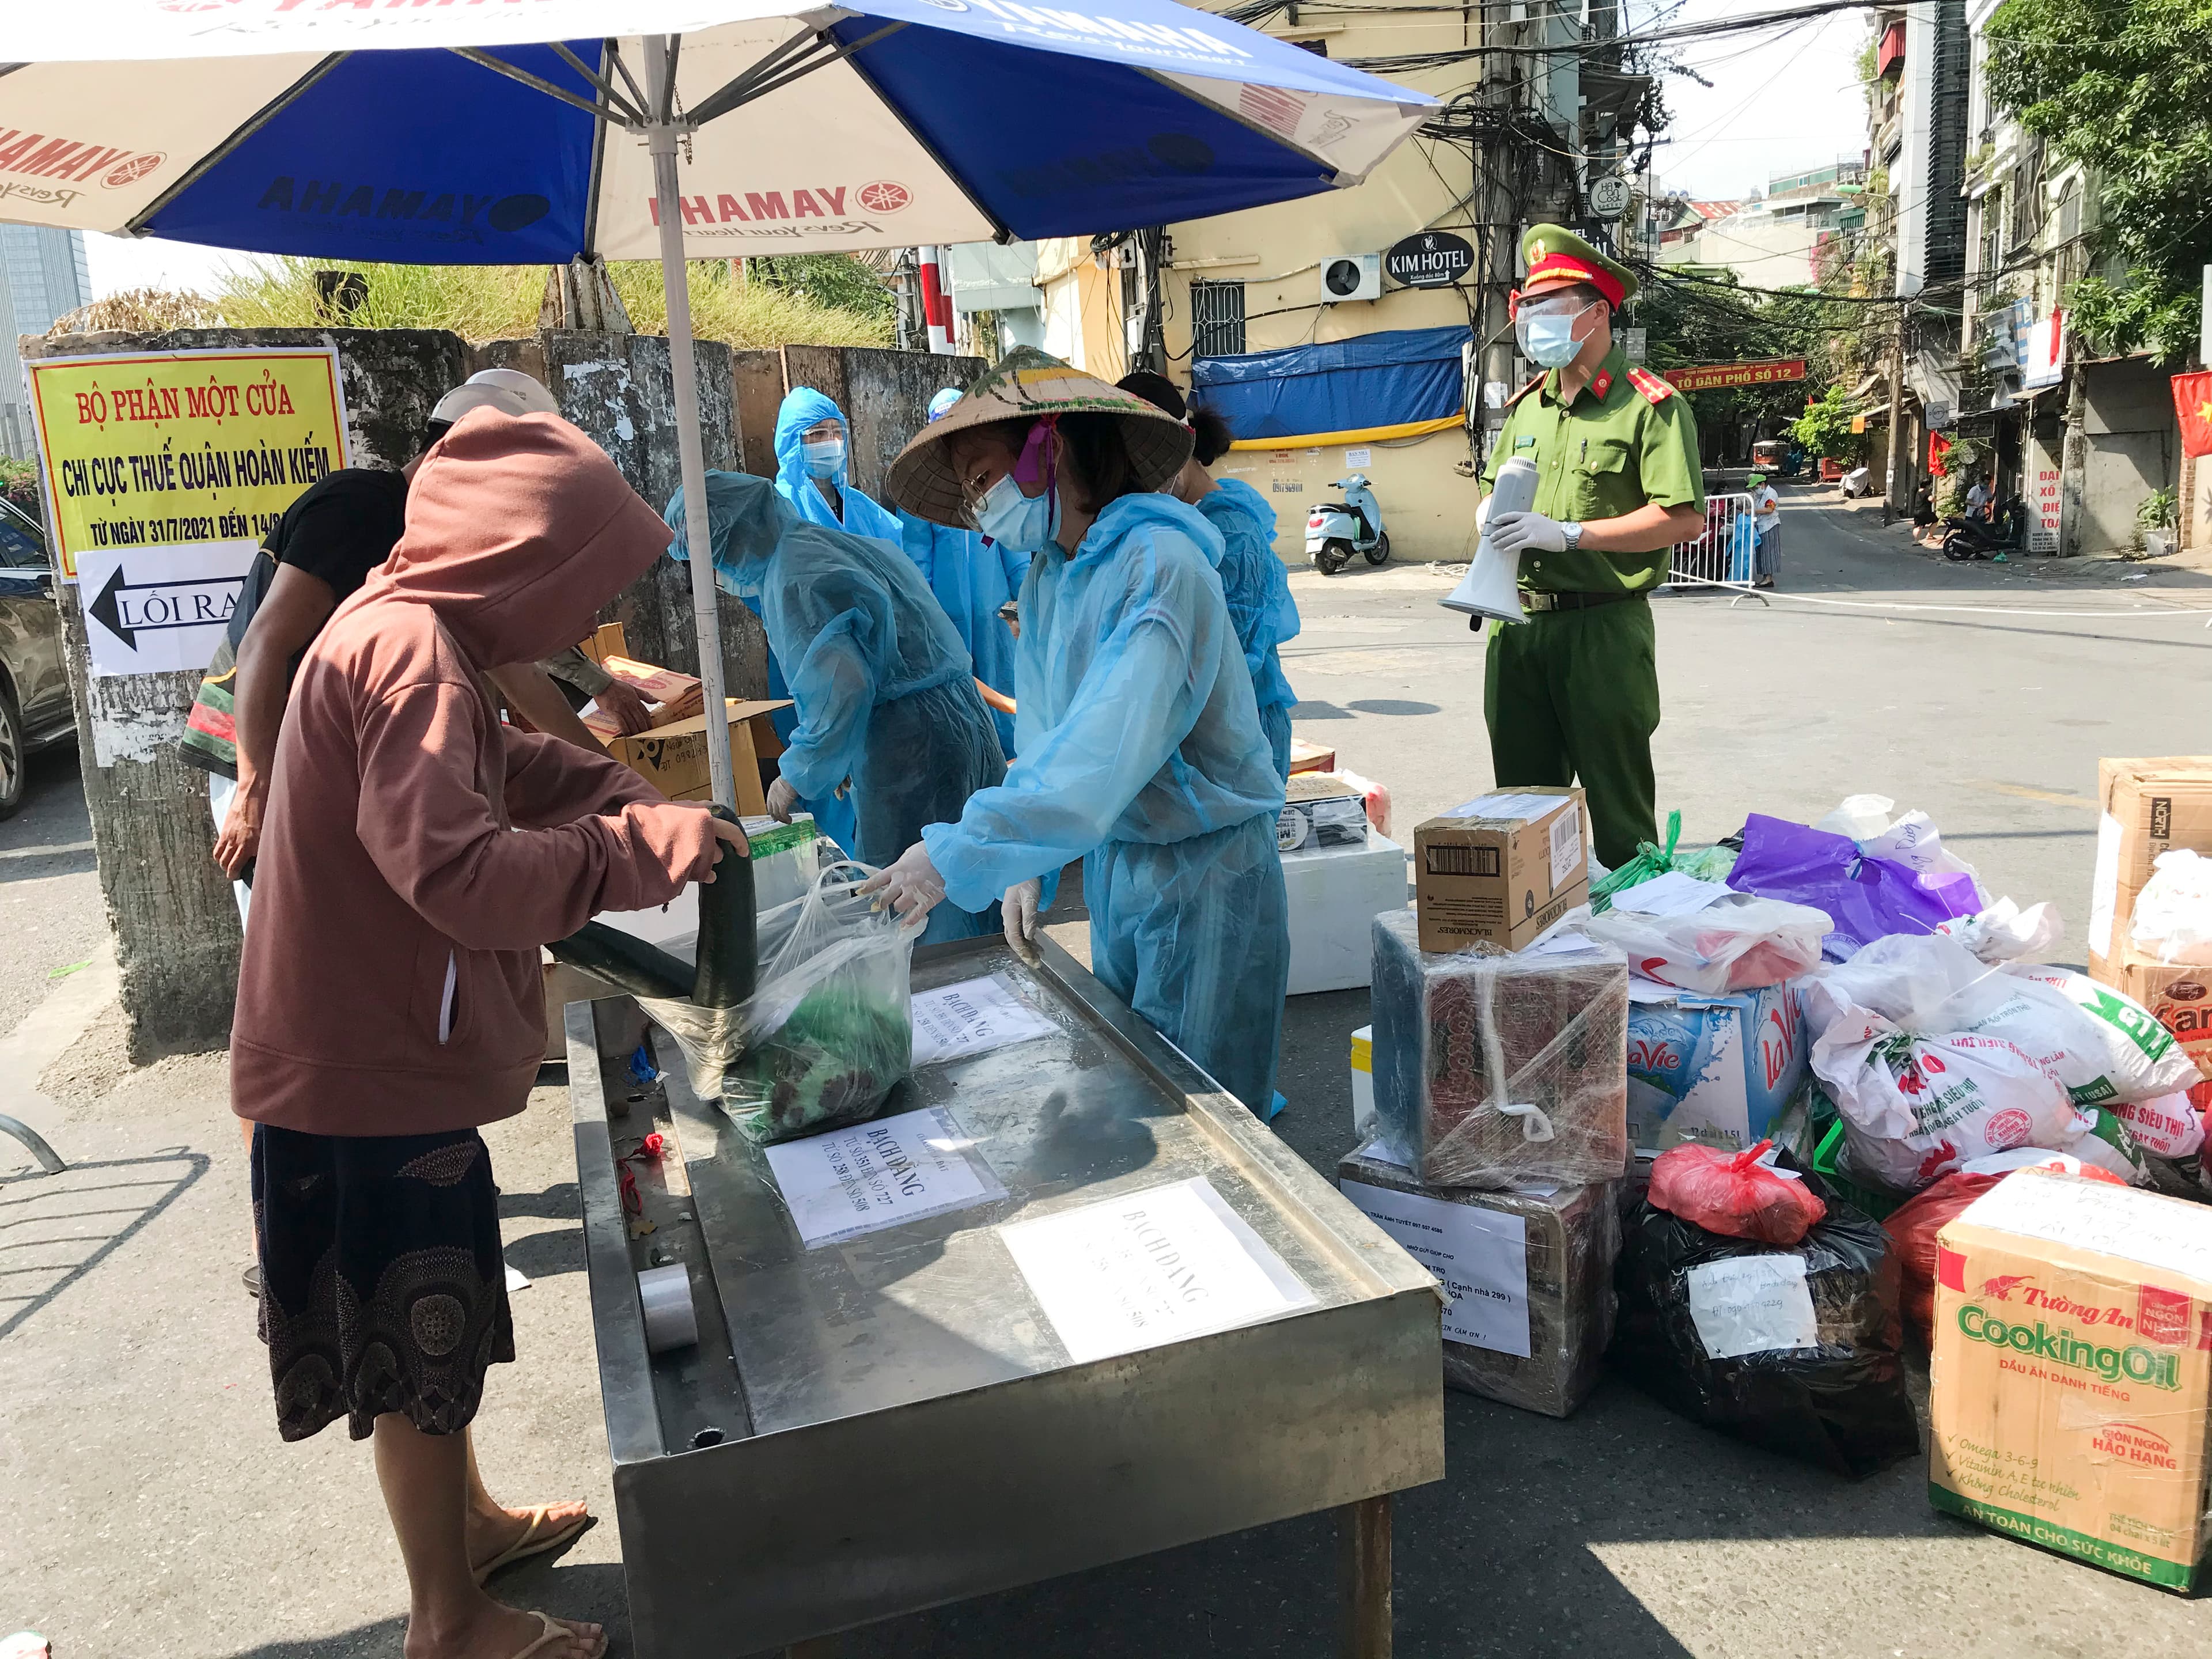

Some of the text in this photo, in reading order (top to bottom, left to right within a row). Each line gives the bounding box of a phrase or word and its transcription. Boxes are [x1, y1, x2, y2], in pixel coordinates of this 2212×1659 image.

[1391, 250, 1469, 274] KIM HOTEL
[1695, 372, 1722, 387] DÂN
[1726, 369, 1751, 384] PHỐ
[1755, 367, 1772, 380] SỐ
[1776, 368, 1791, 379] 12
[75, 369, 295, 431] BỘ PHẬN MỘT CỬA
[62, 431, 330, 506] CHI CỤC THUẾ QUẬN HOÀN KIẾM
[90, 507, 248, 546] TỪ NGÀY 31/7/2021 ĐẾN
[120, 590, 238, 626] LỐI RA
[2154, 801, 2168, 836] NORTH
[1438, 926, 1493, 936] BLACKMORES
[942, 993, 975, 1014] BẠCH
[1627, 1040, 1680, 1071] aVie
[2085, 1084, 2112, 1101] (USA)
[1998, 1120, 2021, 1138] KHÔNG
[2138, 1107, 2163, 1130] SIÊU
[2165, 1115, 2185, 1140] THỊT
[821, 1141, 840, 1153] TỪ
[827, 1151, 844, 1162] SỐ
[849, 1146, 866, 1158] SỐ
[832, 1162, 850, 1176] 258
[866, 1128, 926, 1196] BẠCH ĐẰNG
[846, 1187, 866, 1199] SỐ
[869, 1179, 889, 1192] SỐ
[851, 1198, 870, 1212] 508
[874, 1191, 894, 1206] 727
[1432, 1266, 1446, 1275] TRỌ
[1452, 1282, 1473, 1293] Cạnh
[1475, 1287, 1490, 1297] nhà
[1491, 1291, 1506, 1301] 299
[2023, 1286, 2098, 1325] Tường
[2094, 1307, 2135, 1330] An
[1999, 1357, 2131, 1402] DẦU ĂN DANH TIẾNG
[1959, 1438, 2039, 1469] Omega 3-6-9
[2134, 1436, 2170, 1455] NGON
[2130, 1448, 2177, 1469] HẠNG
[1959, 1454, 2005, 1479] Vitamin
[2020, 1473, 2028, 1484] E
[2031, 1475, 2047, 1492] tự
[2048, 1483, 2083, 1501] nhiên
[1959, 1472, 2061, 1512] Không Cholesterol
[1962, 1504, 2153, 1575] AN TOÀN CHO SỨC KHỎE
[2123, 1528, 2142, 1541] chai
